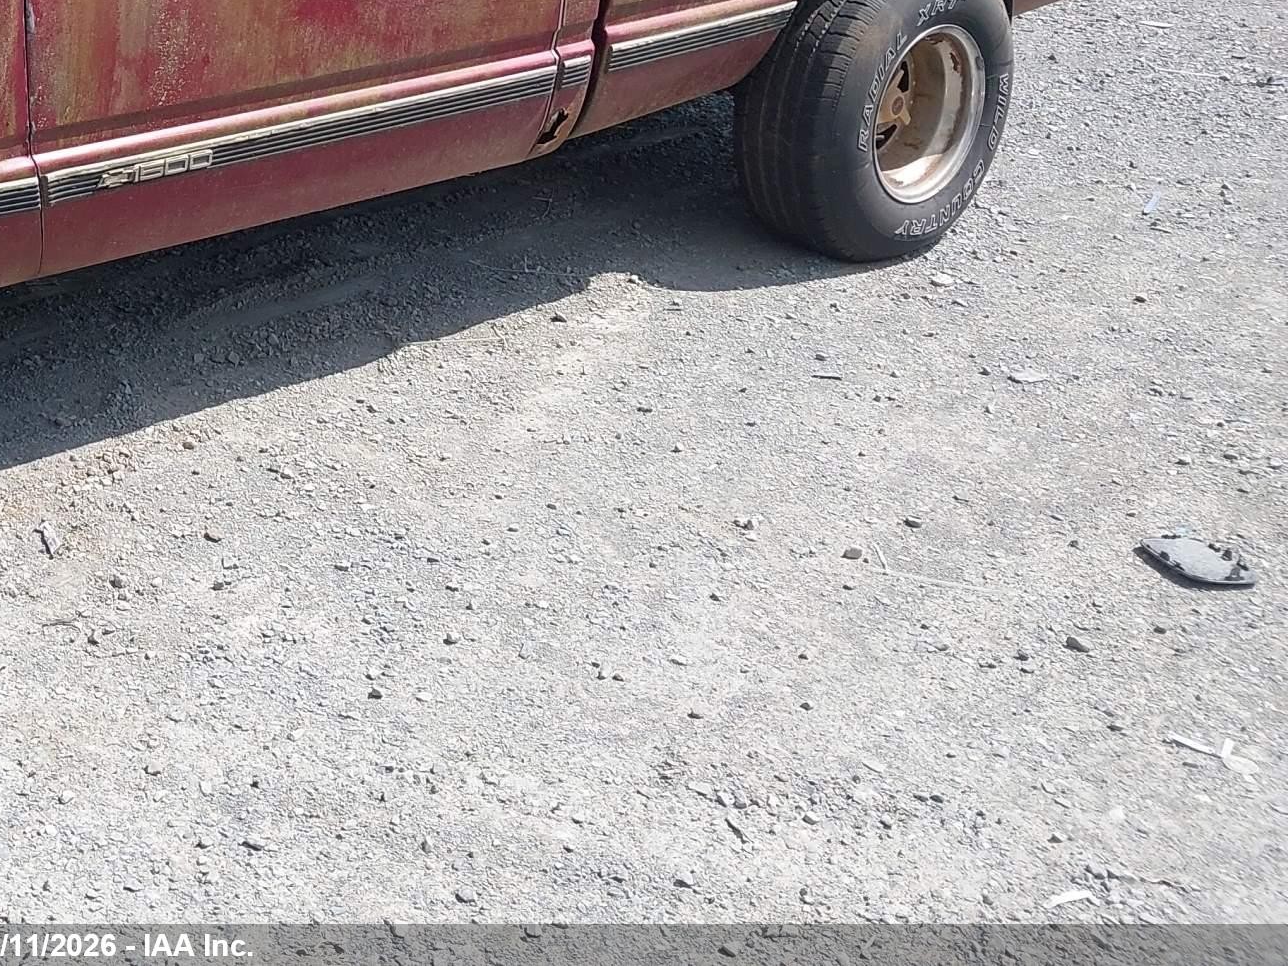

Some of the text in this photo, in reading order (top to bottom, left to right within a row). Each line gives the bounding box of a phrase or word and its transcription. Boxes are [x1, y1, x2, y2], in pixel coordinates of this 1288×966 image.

[857, 31, 908, 152] RADIAL
[894, 73, 1010, 237] WILD COUNTRY
